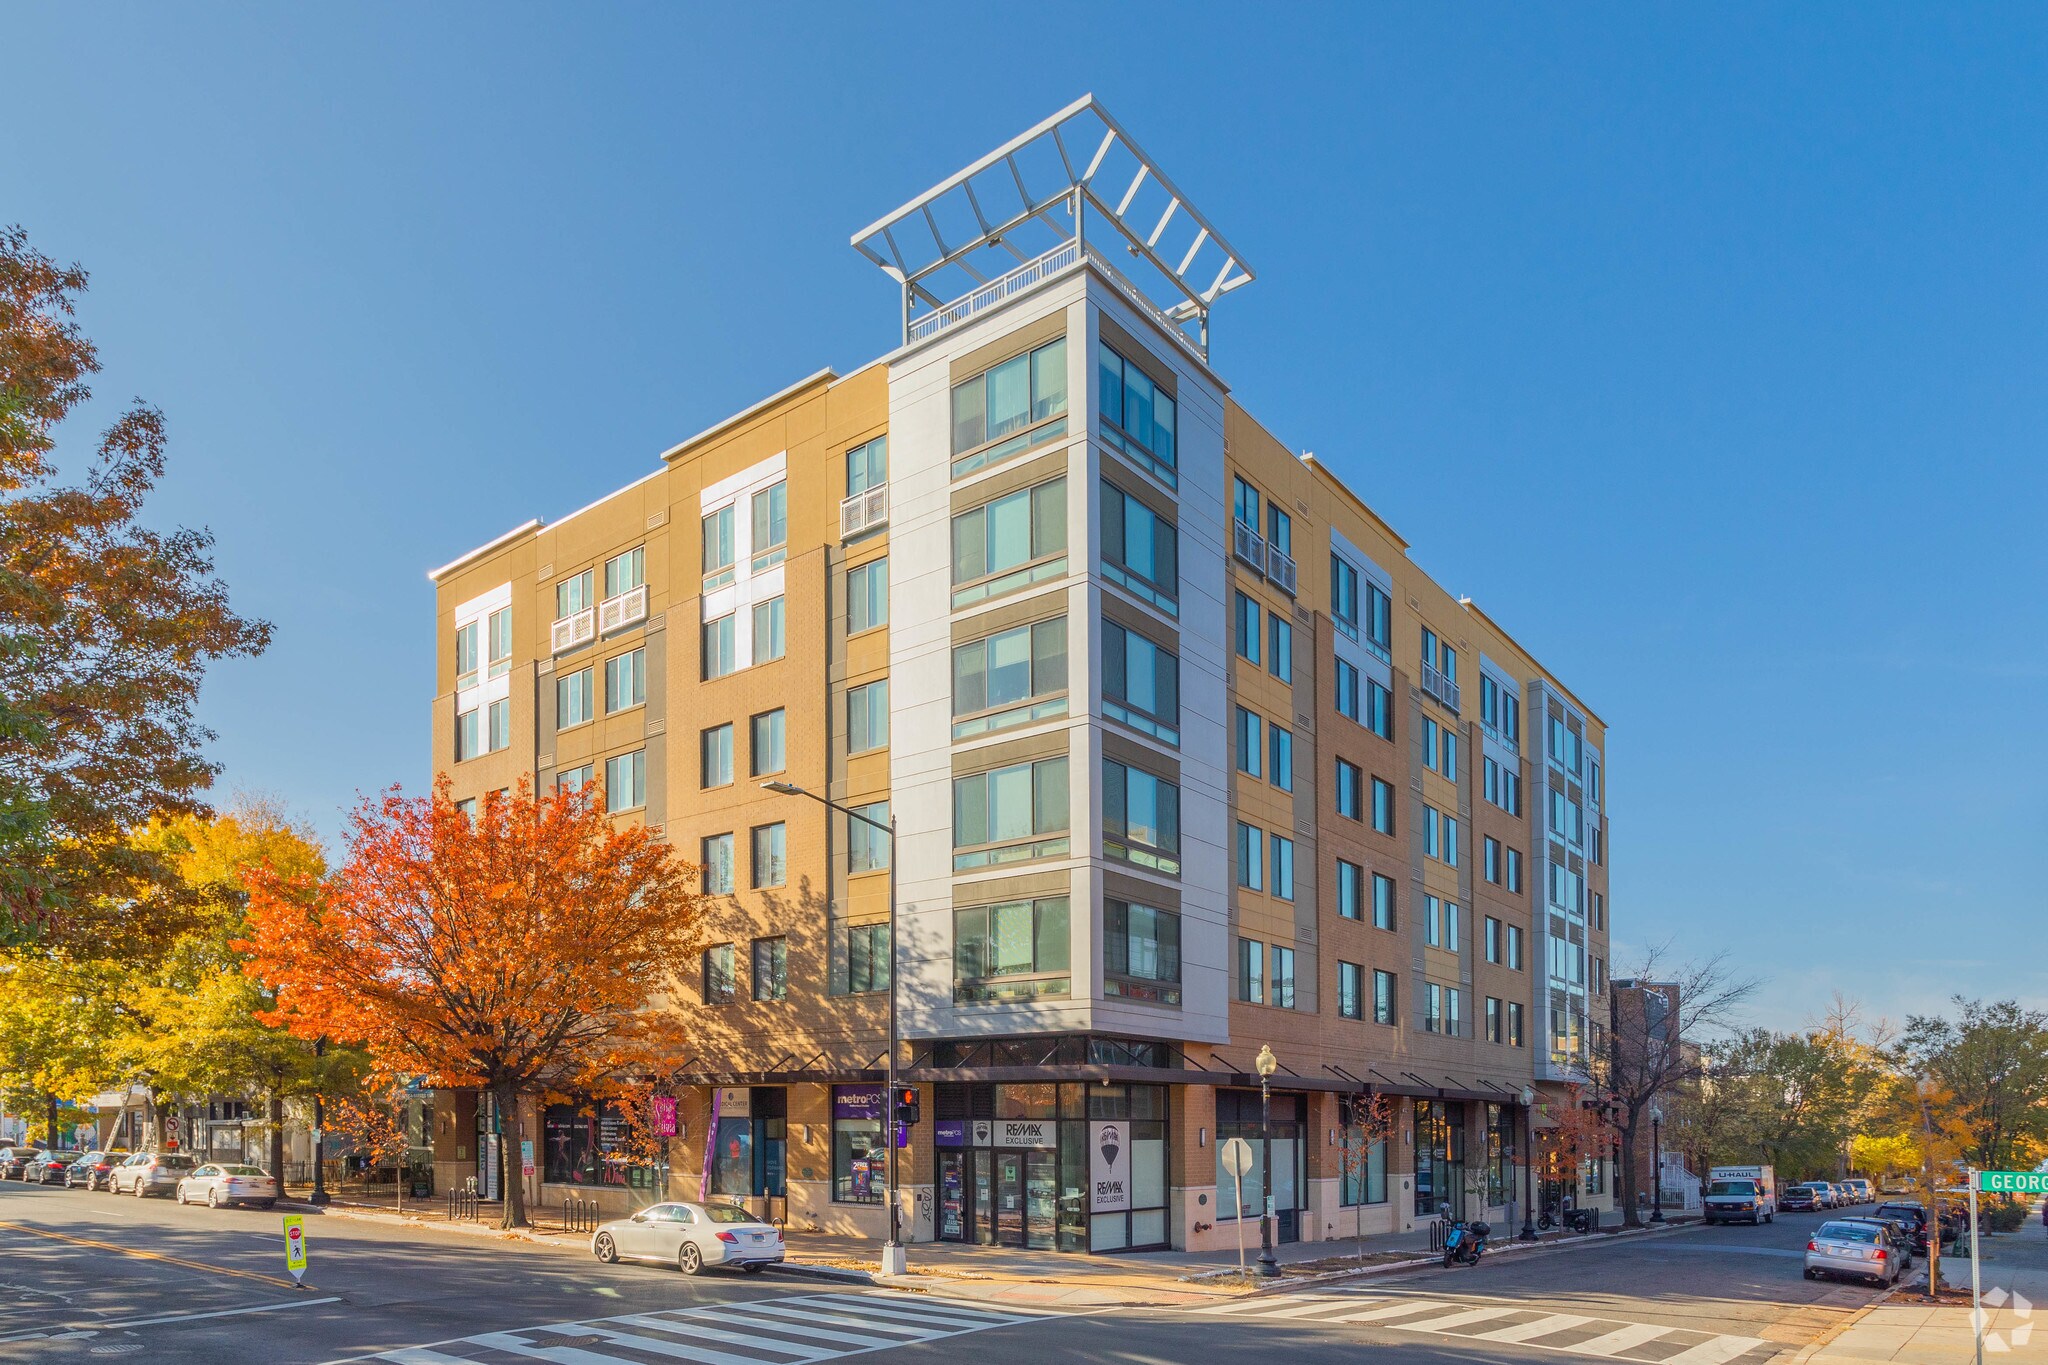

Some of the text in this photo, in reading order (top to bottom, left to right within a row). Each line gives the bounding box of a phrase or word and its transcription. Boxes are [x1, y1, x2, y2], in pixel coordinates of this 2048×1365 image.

[1006, 1123, 1043, 1137] RE/MAX
[1096, 1181, 1123, 1196] RE/MAX
[1096, 1195, 1124, 1204] EXCLUSIVE
